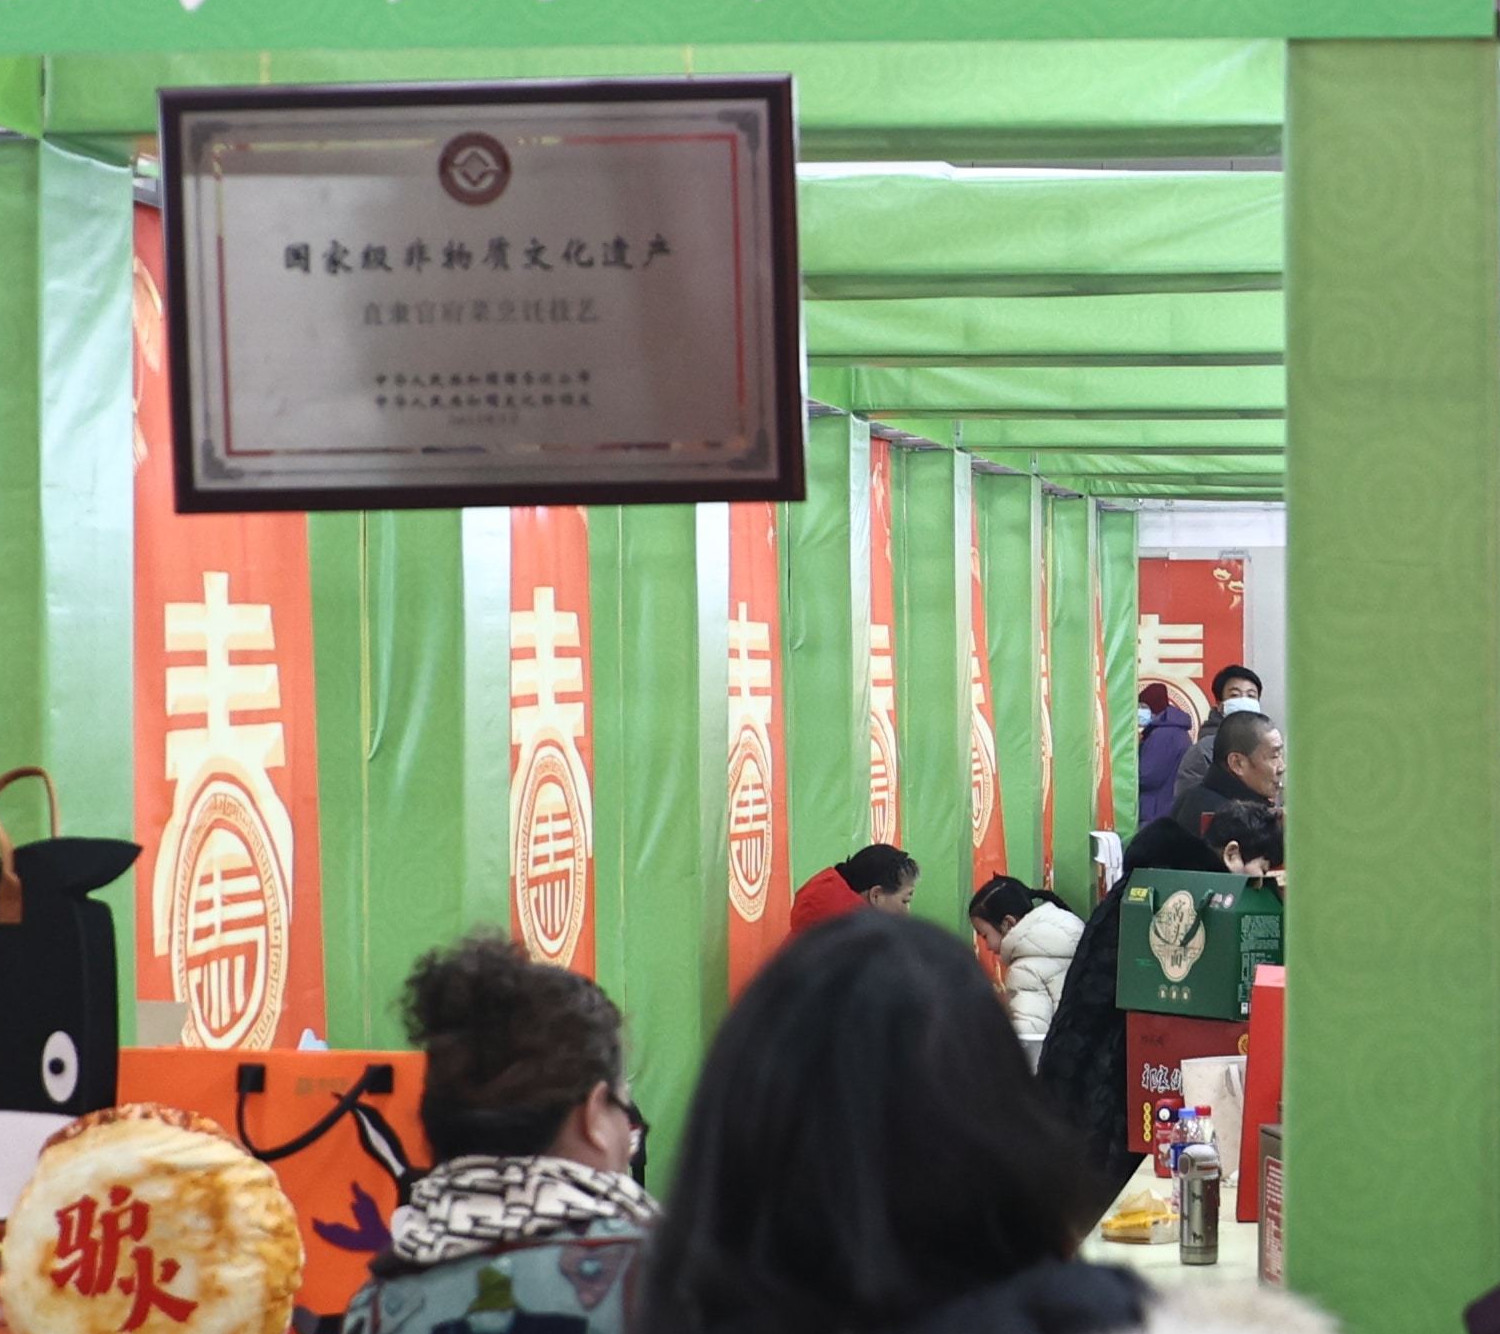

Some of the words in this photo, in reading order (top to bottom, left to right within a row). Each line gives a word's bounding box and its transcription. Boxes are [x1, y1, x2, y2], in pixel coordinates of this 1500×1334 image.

[284, 232, 674, 275] 国家级非物质文化遗产
[51, 1185, 199, 1334] 驴火
